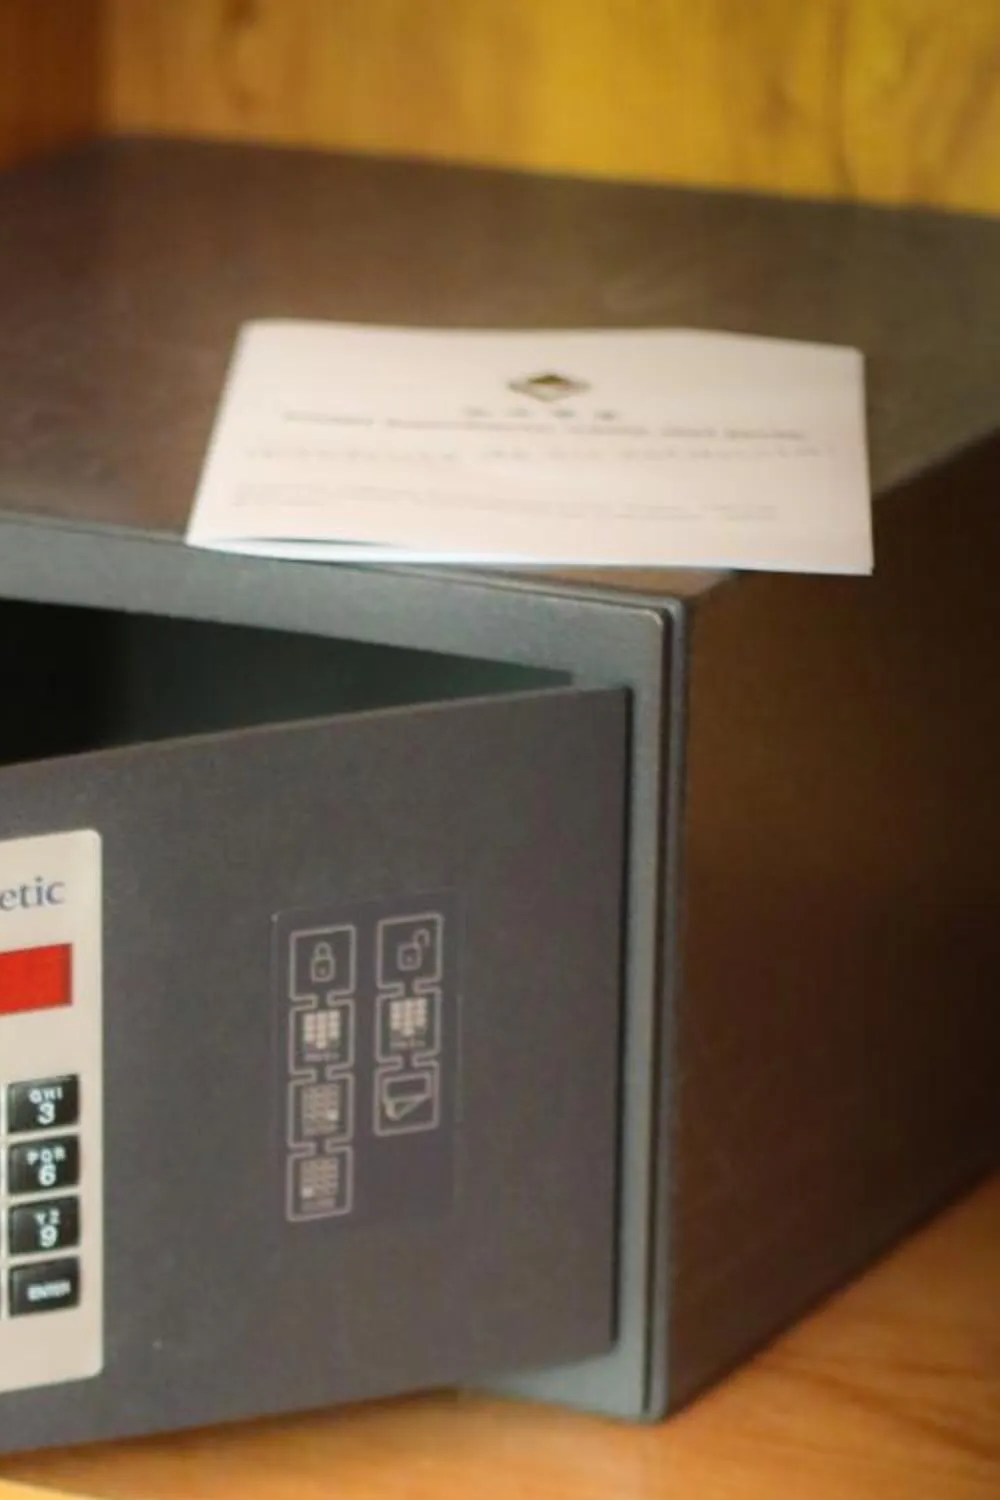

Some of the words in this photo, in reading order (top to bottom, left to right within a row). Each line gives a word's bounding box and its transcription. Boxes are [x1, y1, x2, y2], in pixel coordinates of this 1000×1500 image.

[38, 1102, 55, 1124] 3
[38, 1163, 57, 1186] 6
[39, 1225, 58, 1248] 9
